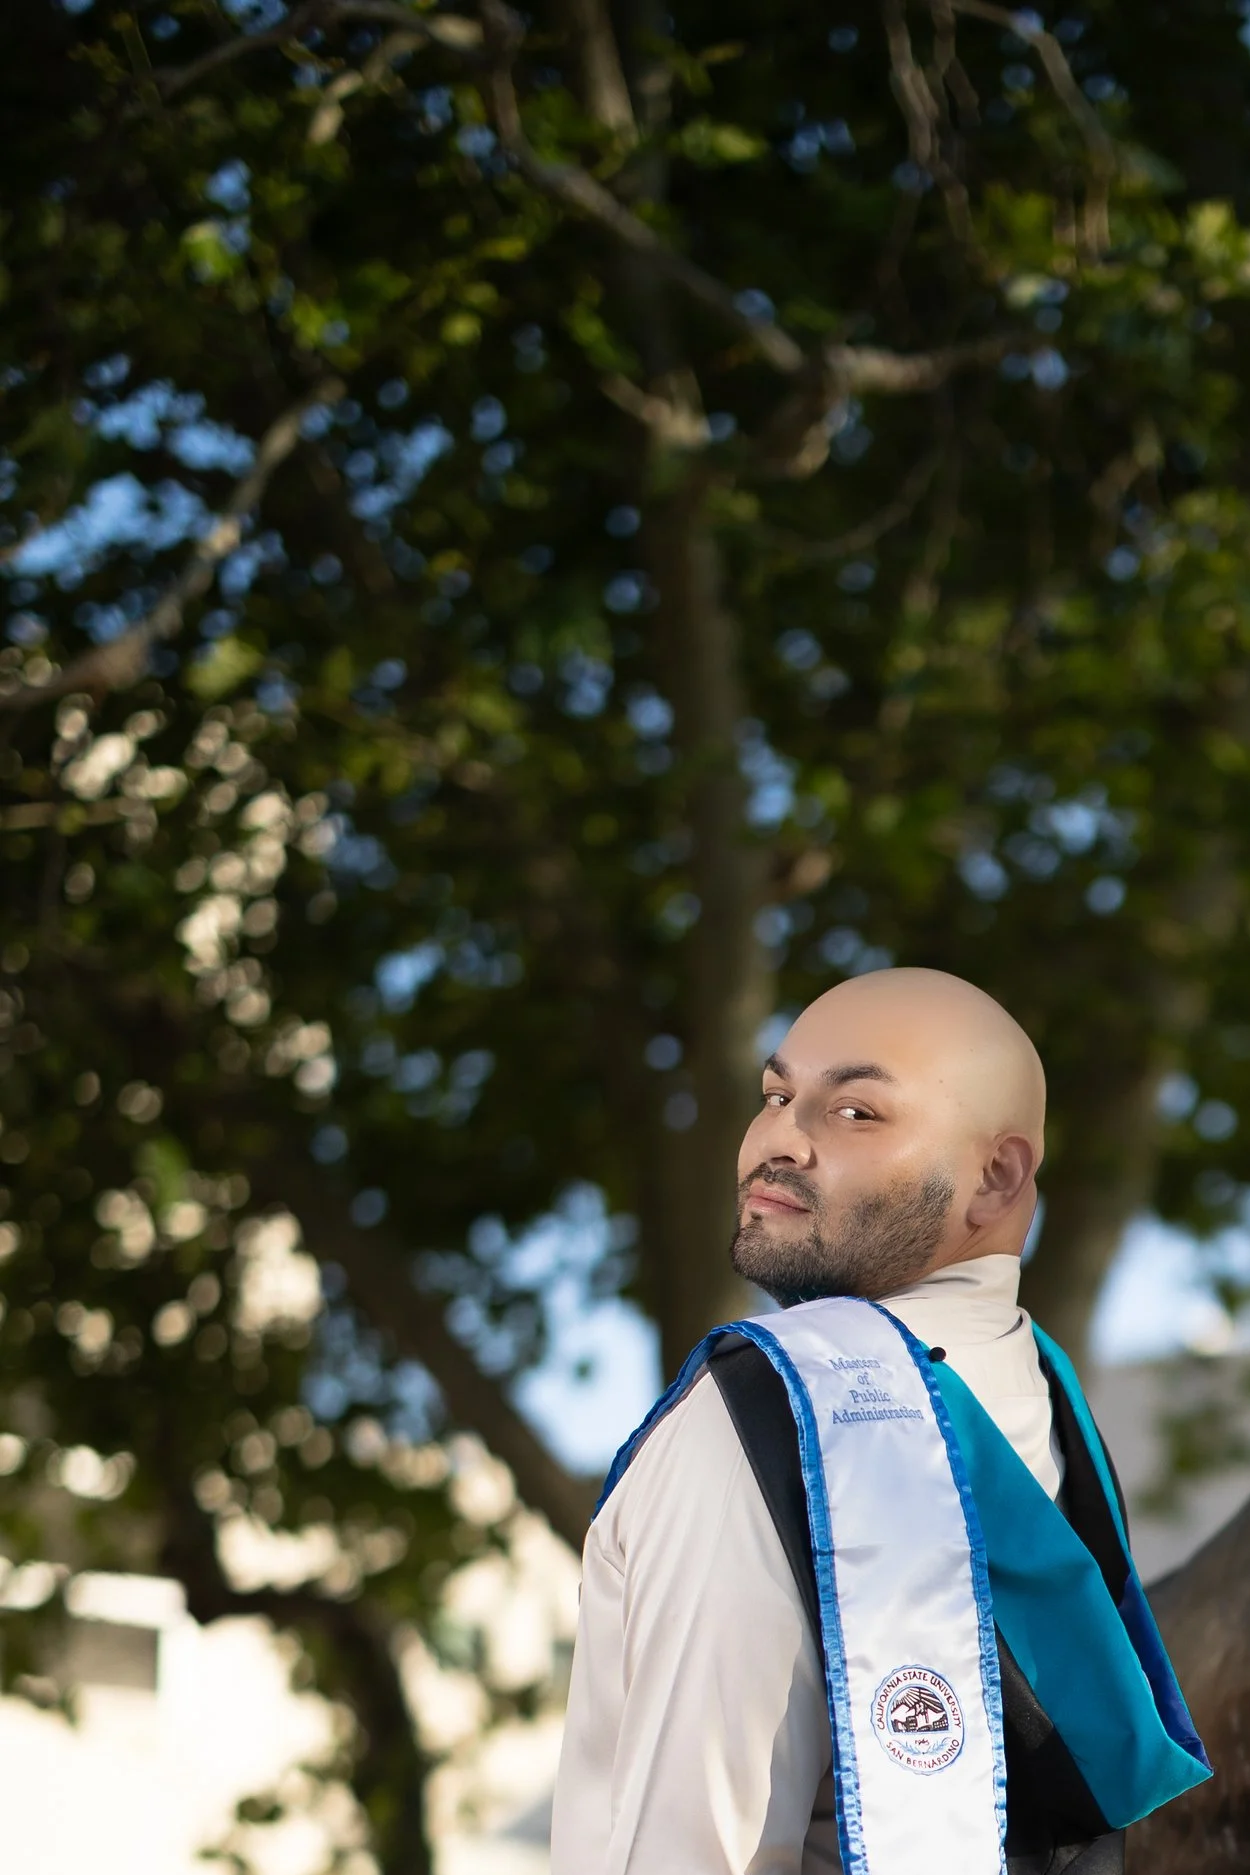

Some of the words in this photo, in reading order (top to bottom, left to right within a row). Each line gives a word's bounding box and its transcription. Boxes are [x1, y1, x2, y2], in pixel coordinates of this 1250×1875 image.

[857, 1372, 870, 1386] of
[849, 1389, 891, 1404] Public
[832, 1407, 924, 1424] Administration
[876, 1676, 902, 1730] CALIFORNIA
[902, 1671, 928, 1682] STATE
[930, 1675, 962, 1728] UNIVERSITY
[886, 1741, 904, 1760] SAN
[906, 1738, 960, 1769] BERNARDINO
